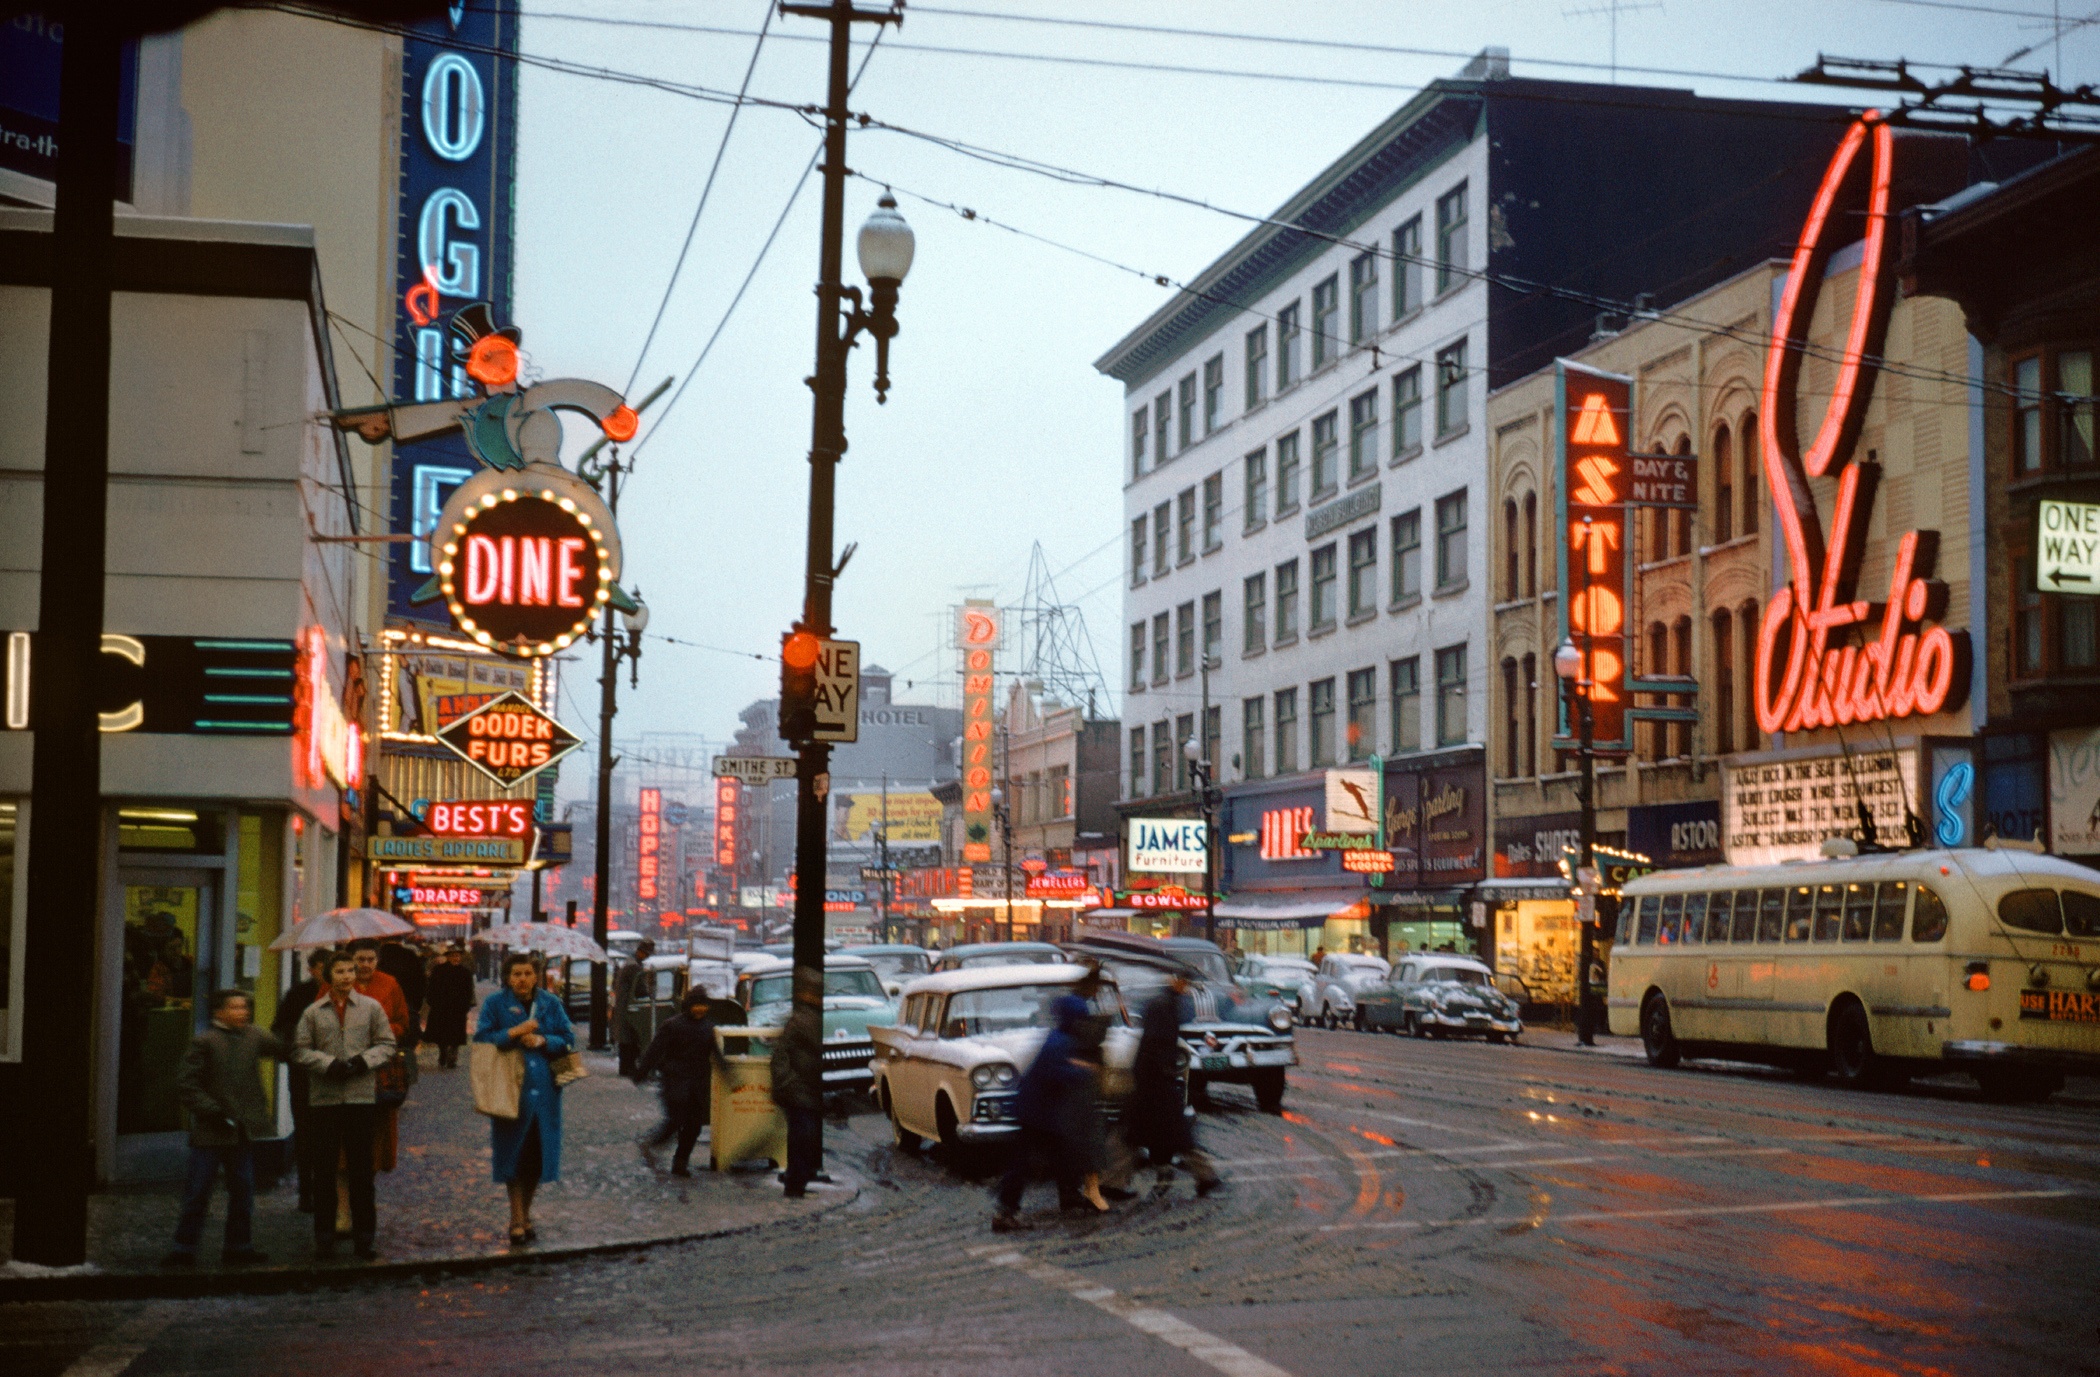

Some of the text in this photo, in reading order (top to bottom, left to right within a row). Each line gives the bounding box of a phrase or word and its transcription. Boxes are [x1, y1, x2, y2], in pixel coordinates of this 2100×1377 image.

[1753, 108, 1955, 733] Studio
[1633, 458, 1688, 481] DAY &
[1633, 483, 1687, 502] NITE
[2045, 504, 2098, 533] ONE
[1571, 394, 1622, 702] ASTOR
[2044, 536, 2099, 565] WAY
[464, 533, 587, 608] DINE
[818, 648, 852, 678] NE
[815, 683, 853, 712] AY
[965, 610, 996, 813] DOMINION
[468, 711, 554, 740] DODEK
[861, 709, 930, 726] HOTEL
[467, 739, 552, 768] FURS
[720, 759, 767, 775] SMITHE
[433, 804, 526, 833] BEST'S
[1937, 762, 1976, 846] S
[374, 839, 517, 860] LADIES APPAREL
[638, 788, 661, 899] HOPES
[1136, 824, 1207, 852] JAMES
[1671, 819, 1719, 851] ASTOR
[413, 887, 481, 905] DRAPES
[1028, 876, 1087, 889] JEWELLERS
[2020, 993, 2045, 1010] USE
